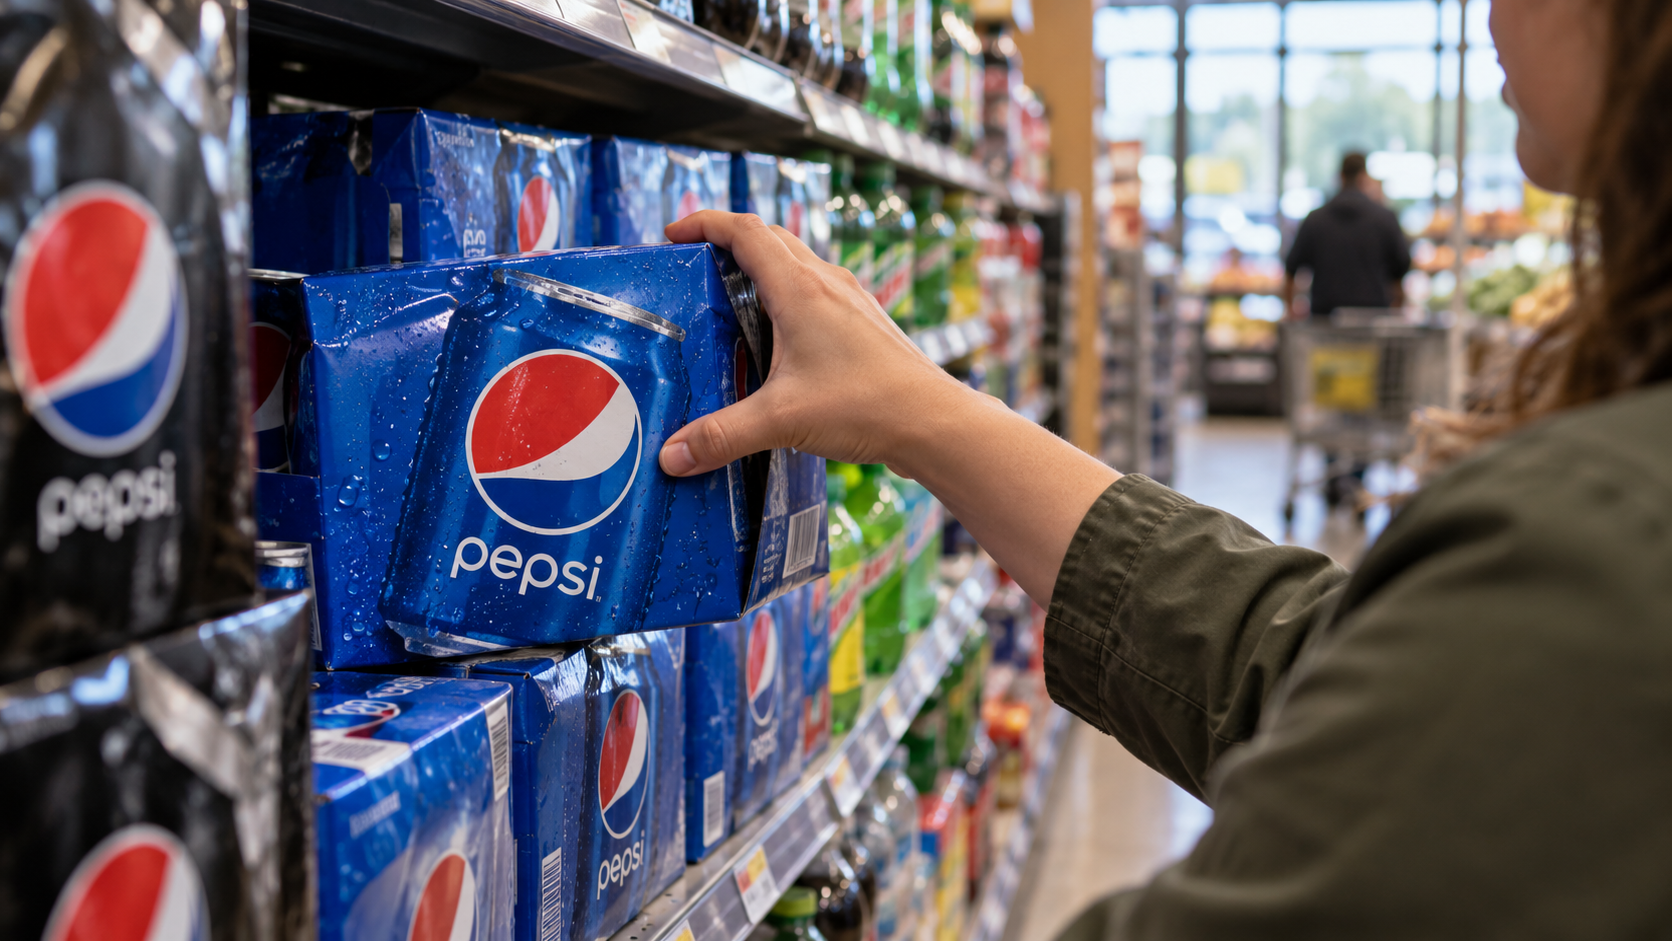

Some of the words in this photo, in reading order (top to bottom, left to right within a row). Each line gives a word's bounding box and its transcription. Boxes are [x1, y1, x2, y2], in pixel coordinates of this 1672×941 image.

[37, 450, 176, 553] pepsi
[450, 536, 603, 600] pepsi
[597, 830, 645, 900] pepsi
